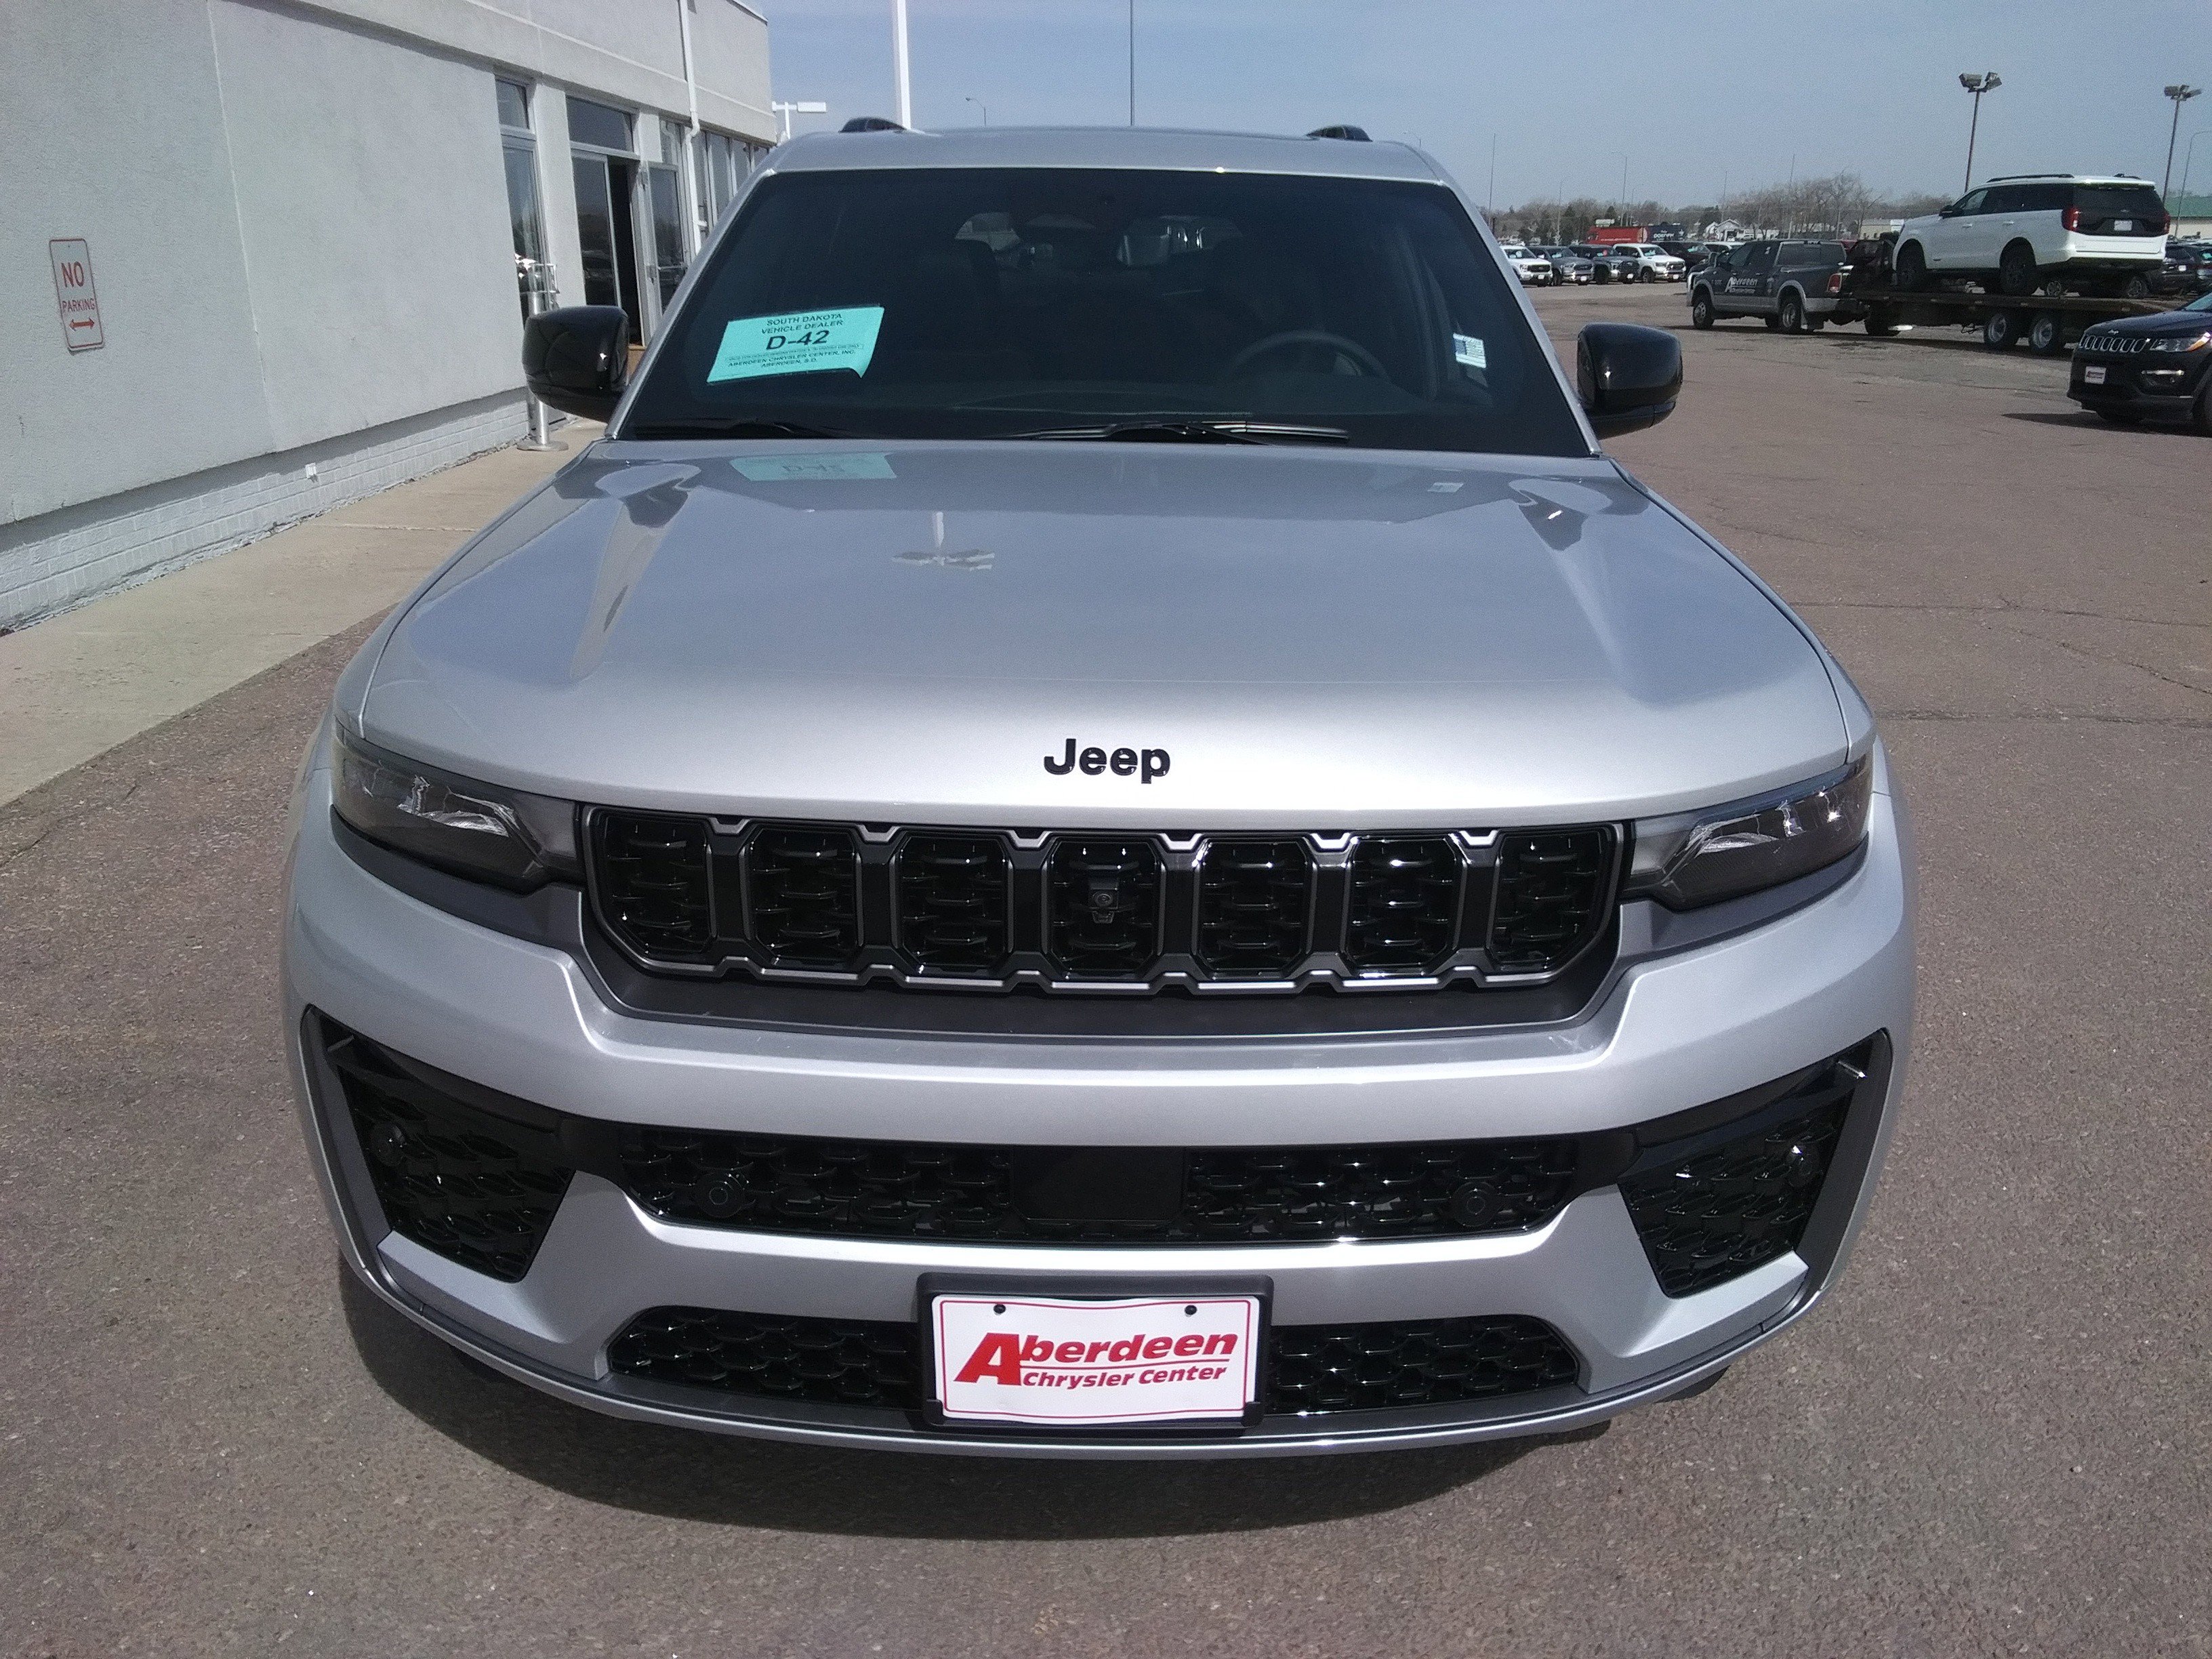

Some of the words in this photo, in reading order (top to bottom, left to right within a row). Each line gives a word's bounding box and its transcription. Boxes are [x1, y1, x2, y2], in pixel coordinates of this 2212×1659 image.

[61, 261, 84, 287] NO
[62, 298, 95, 313] PARKING
[762, 325, 802, 334] VEHICLE
[804, 320, 844, 329] DEALER
[767, 317, 800, 326] SOUTH
[802, 314, 842, 323] DAKOTA
[766, 330, 830, 350] D-42
[728, 357, 767, 367] ABERDEEN
[1044, 738, 1170, 784] Jeep
[954, 1332, 1238, 1386] Aberdeen
[1023, 1372, 1135, 1390] Chrysler
[1139, 1366, 1227, 1384] Center
